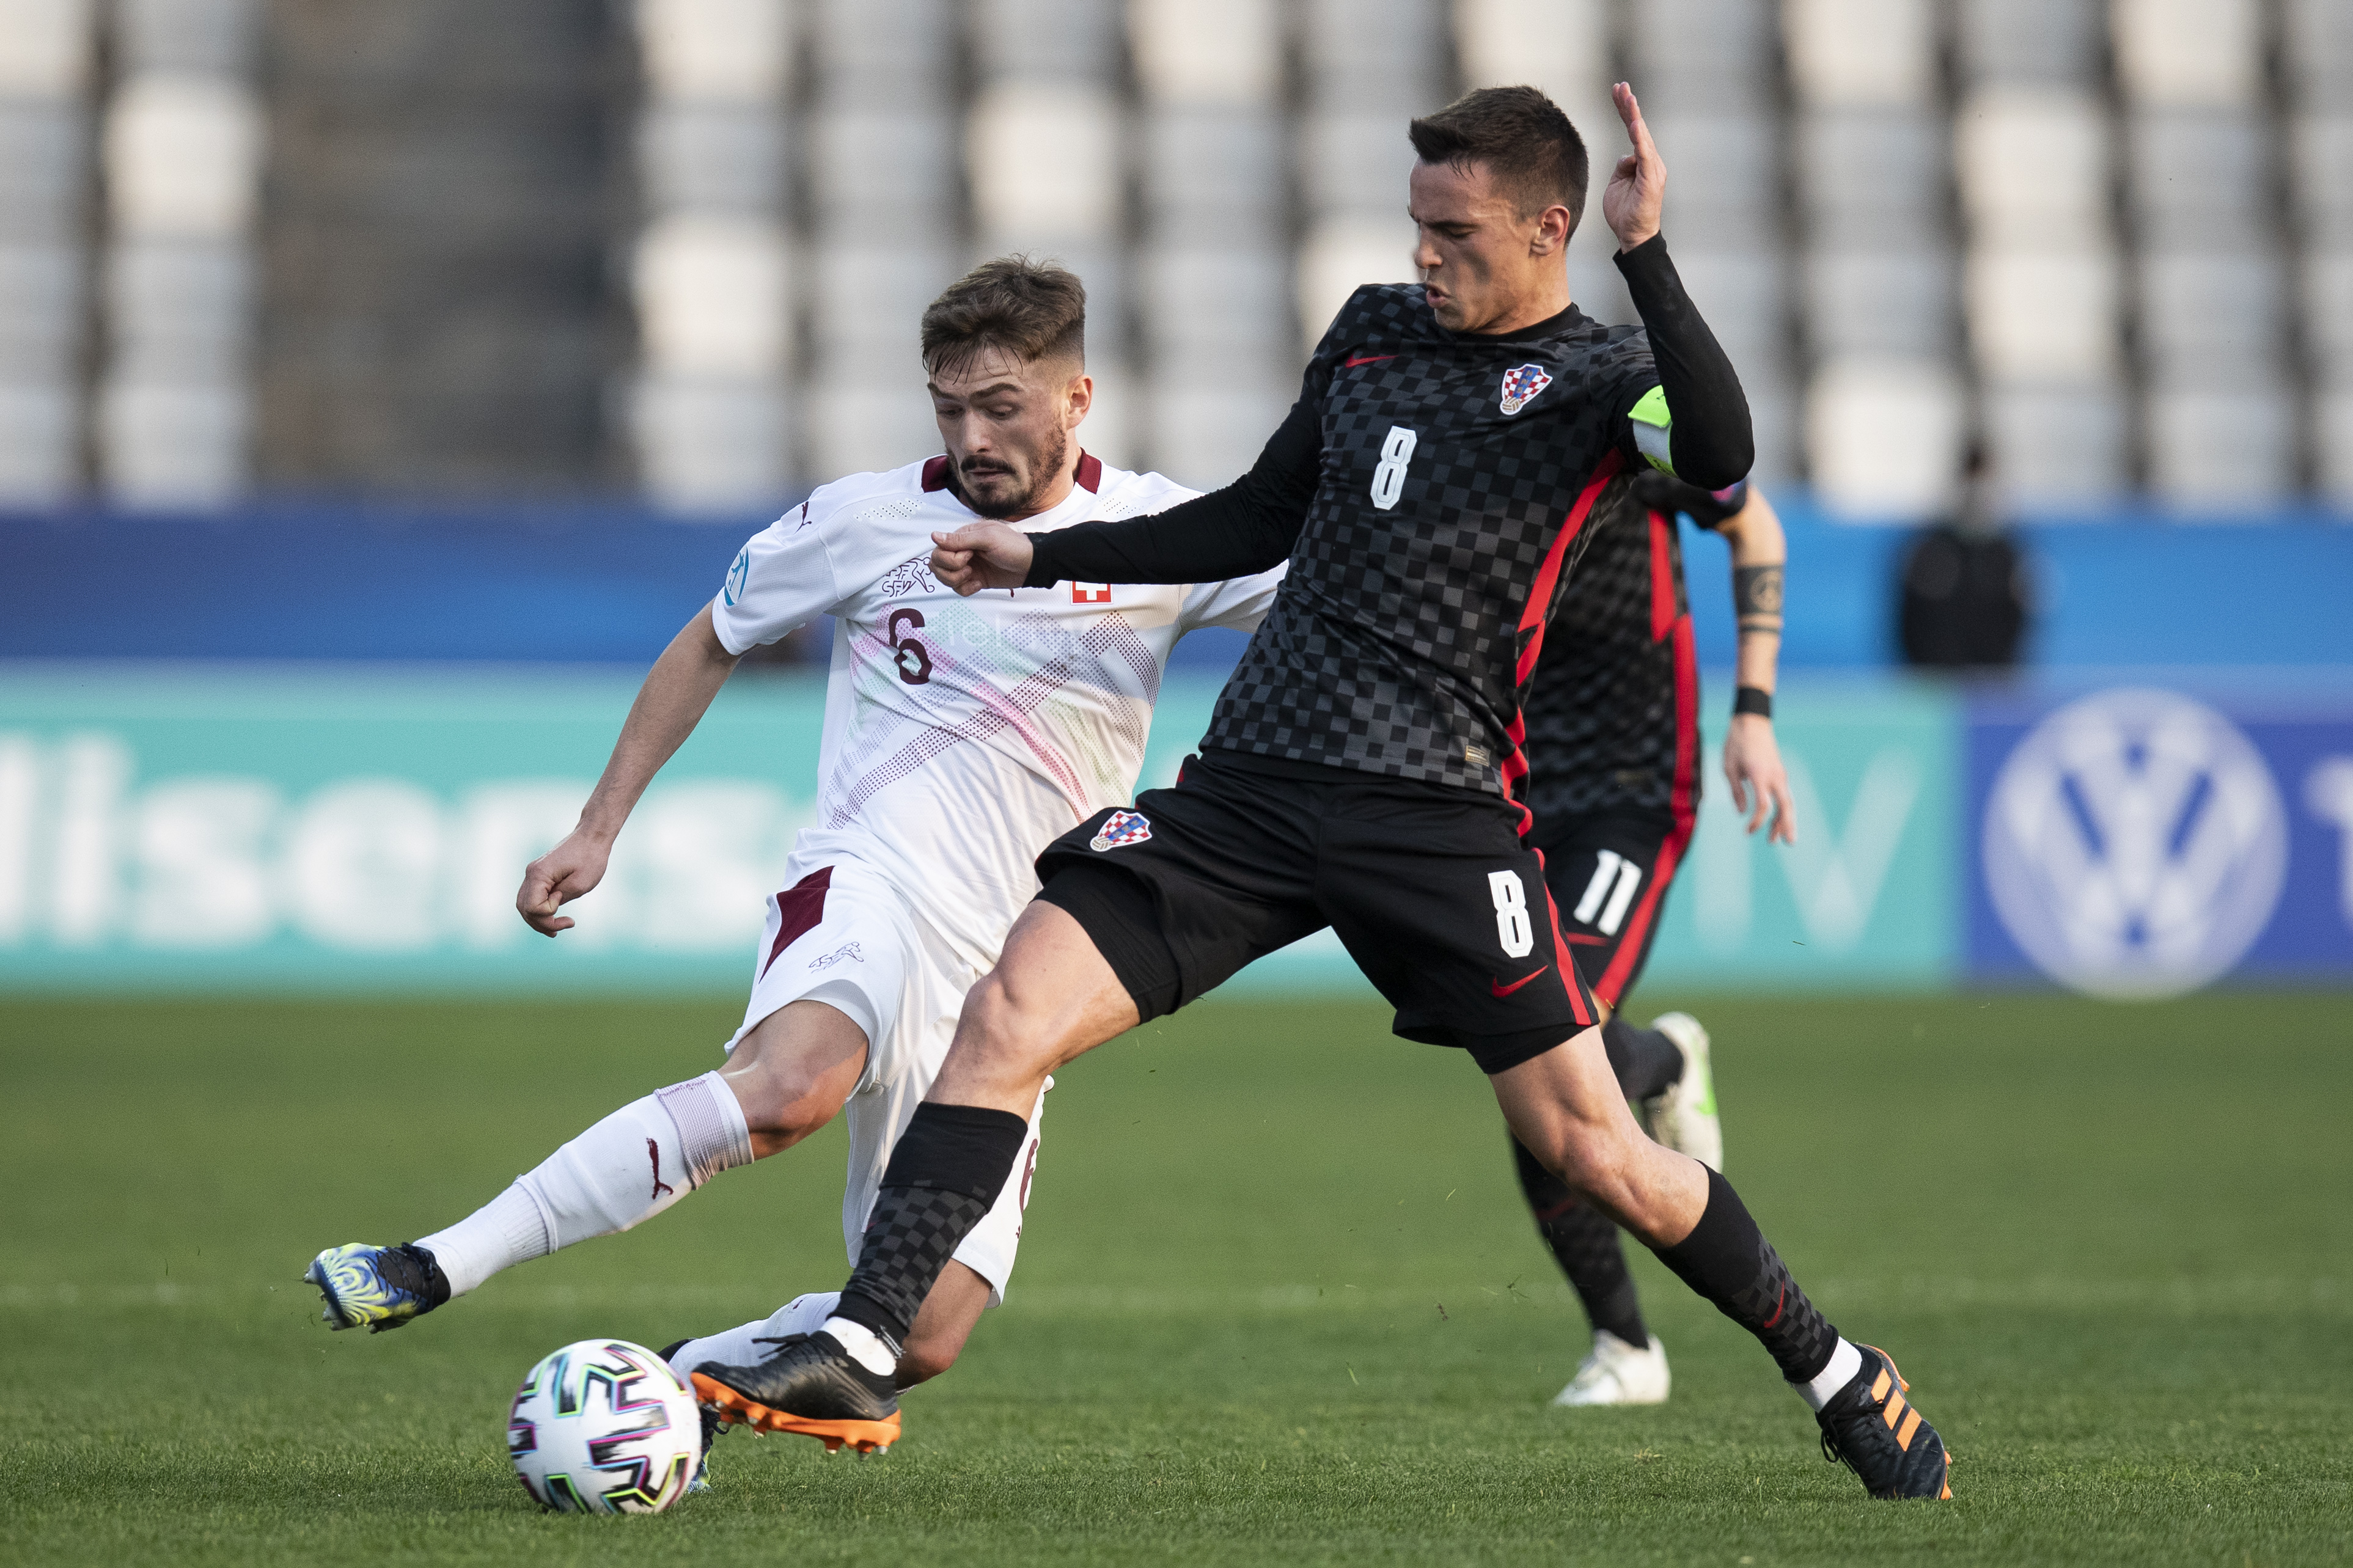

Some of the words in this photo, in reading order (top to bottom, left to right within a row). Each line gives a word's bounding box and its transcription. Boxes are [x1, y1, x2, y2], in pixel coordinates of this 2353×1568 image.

[1370, 426, 1417, 510] 8
[888, 608, 933, 685] 6
[1488, 870, 1534, 958] 8
[1573, 849, 1643, 936] 11
